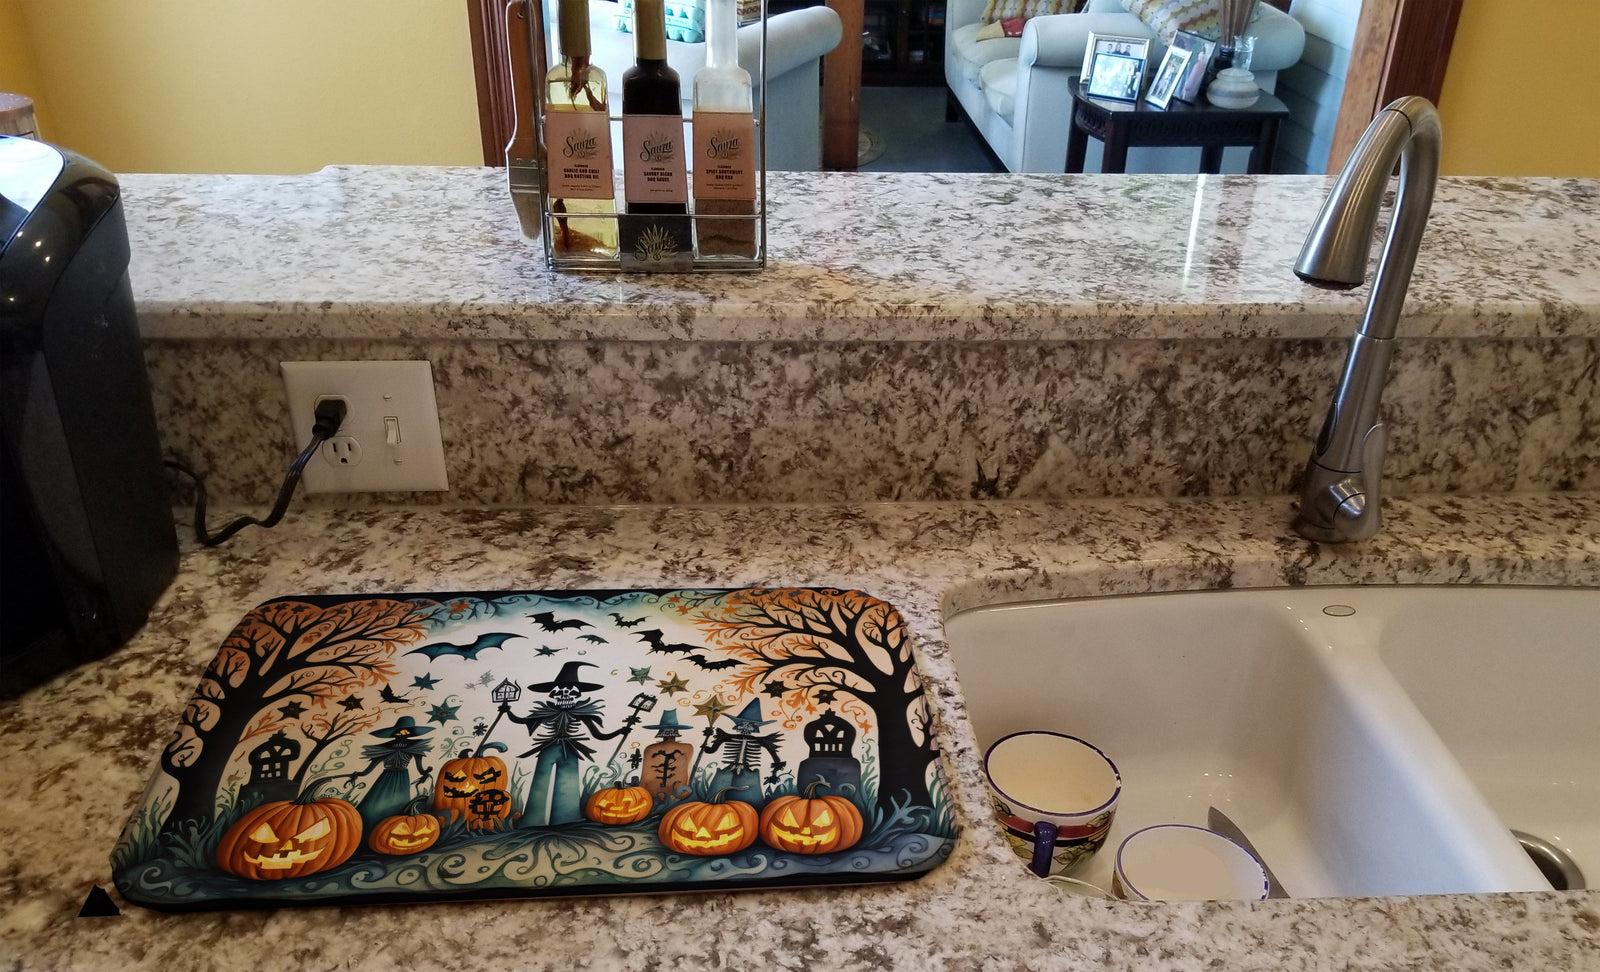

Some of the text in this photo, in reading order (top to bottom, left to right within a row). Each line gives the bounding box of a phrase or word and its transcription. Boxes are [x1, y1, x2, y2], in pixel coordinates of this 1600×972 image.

[563, 136, 597, 158] Sauza
[640, 140, 673, 162] Sauza
[706, 136, 740, 158] Sauza
